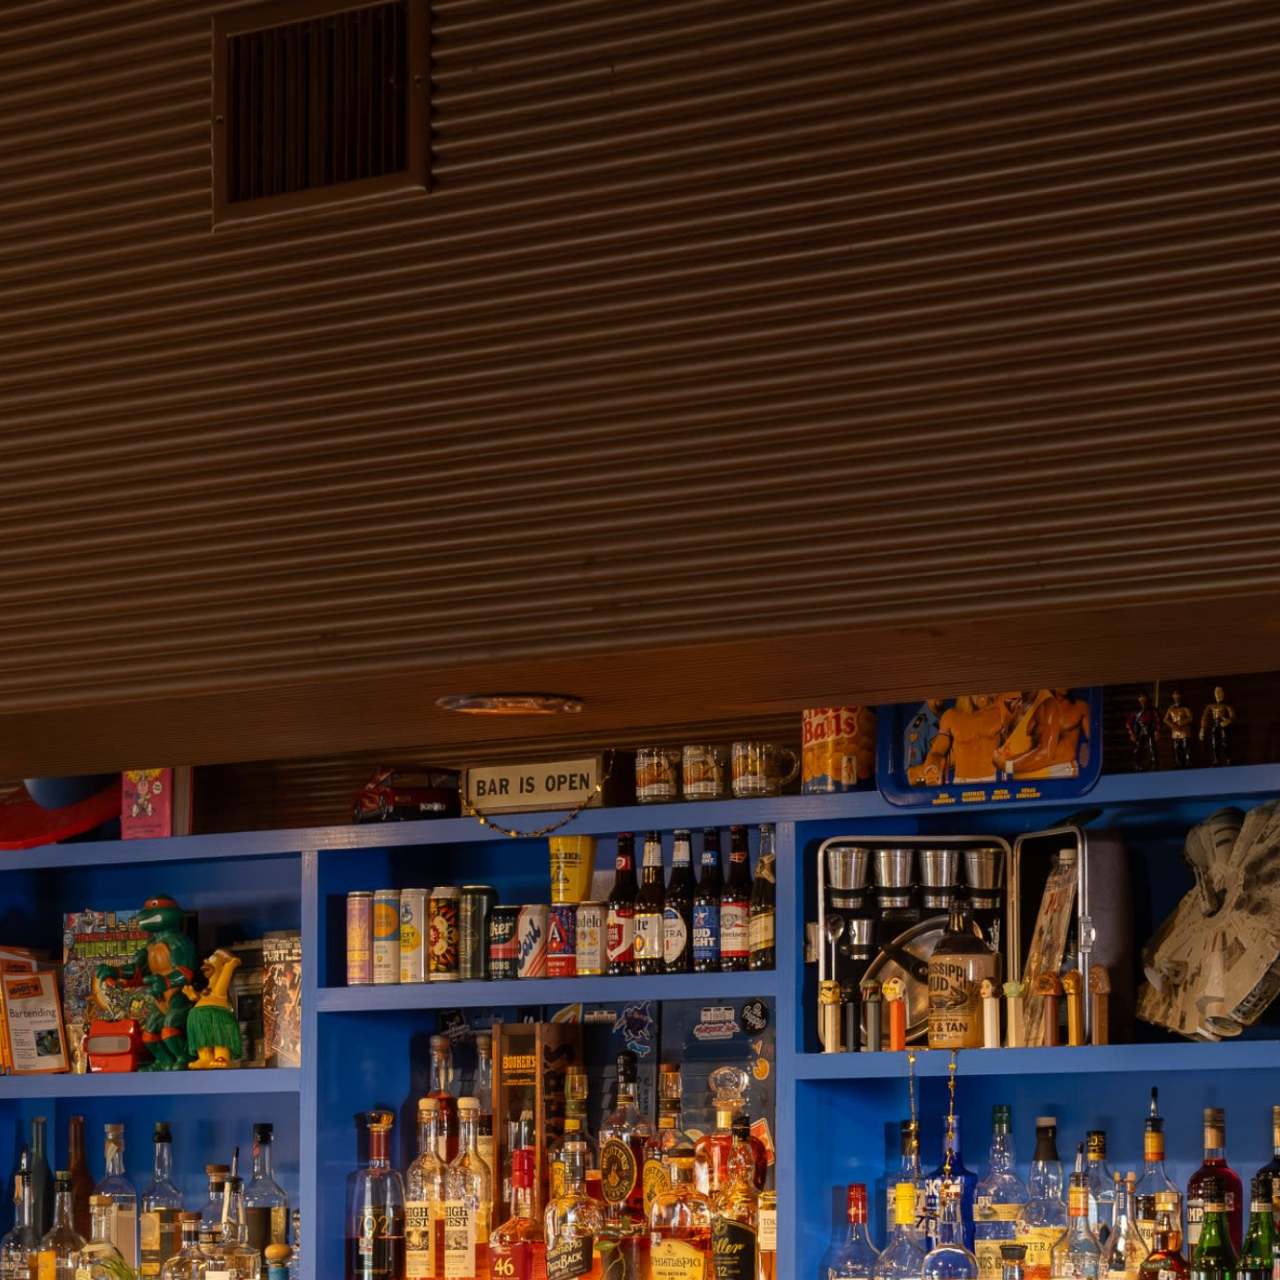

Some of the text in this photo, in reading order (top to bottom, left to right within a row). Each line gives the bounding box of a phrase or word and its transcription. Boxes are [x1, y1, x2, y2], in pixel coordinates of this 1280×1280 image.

[803, 712, 856, 744] Balls
[476, 773, 590, 797] BAR IS OPEN
[9, 1006, 57, 1020] Bartending
[946, 1022, 969, 1033] TAN
[494, 1258, 515, 1276] 46
